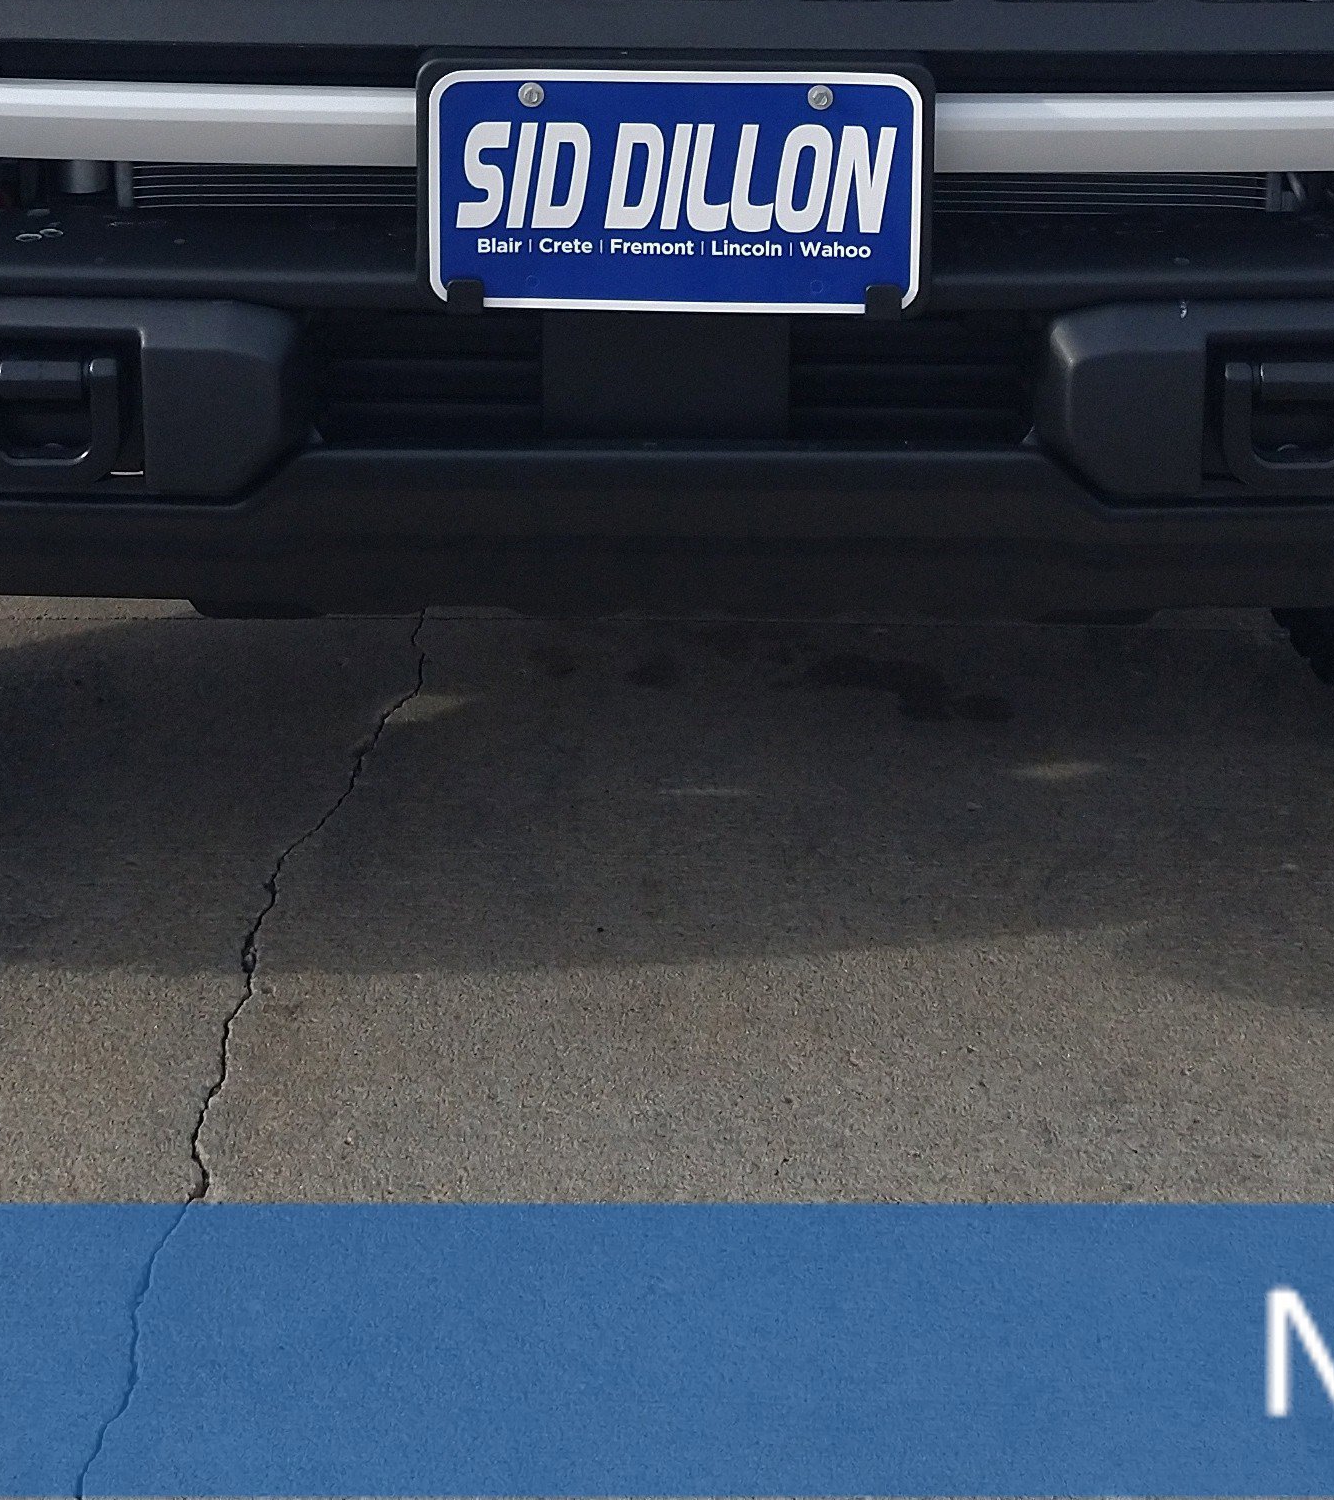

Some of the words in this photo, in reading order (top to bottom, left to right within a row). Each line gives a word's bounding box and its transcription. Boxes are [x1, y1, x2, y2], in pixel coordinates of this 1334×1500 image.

[455, 121, 591, 229] SID
[603, 122, 898, 234] DILLON
[477, 237, 523, 254] Blair
[538, 237, 593, 254] Crete
[610, 238, 695, 256] Fremont
[711, 239, 783, 257] Lincoln
[799, 240, 872, 259] Wahoo
